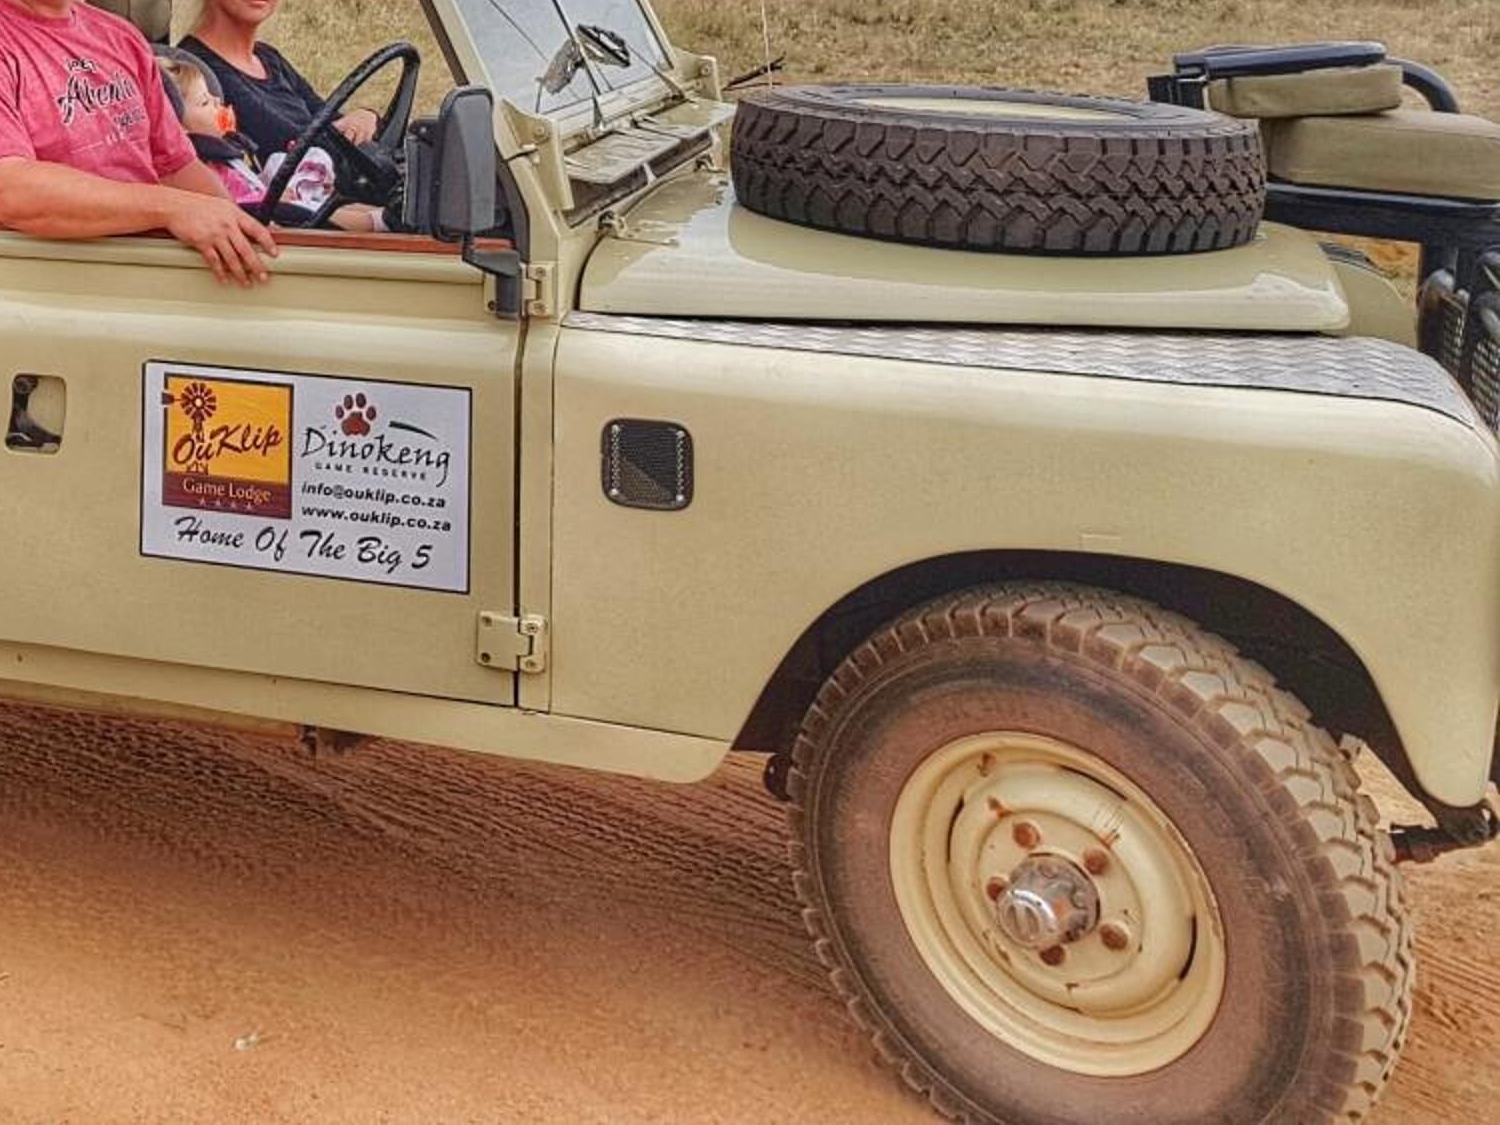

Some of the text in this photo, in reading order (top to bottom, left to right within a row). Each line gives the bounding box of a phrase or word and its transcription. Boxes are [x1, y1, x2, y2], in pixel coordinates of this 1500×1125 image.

[301, 427, 450, 488] Dinokeng
[315, 461, 426, 481] GAME RESERVE
[183, 477, 272, 505] Game Lodge
[301, 481, 446, 509] info@ouklip.co.za
[301, 506, 452, 532] www.ouklip.co.za
[174, 516, 433, 574] Home Of The Big 5
